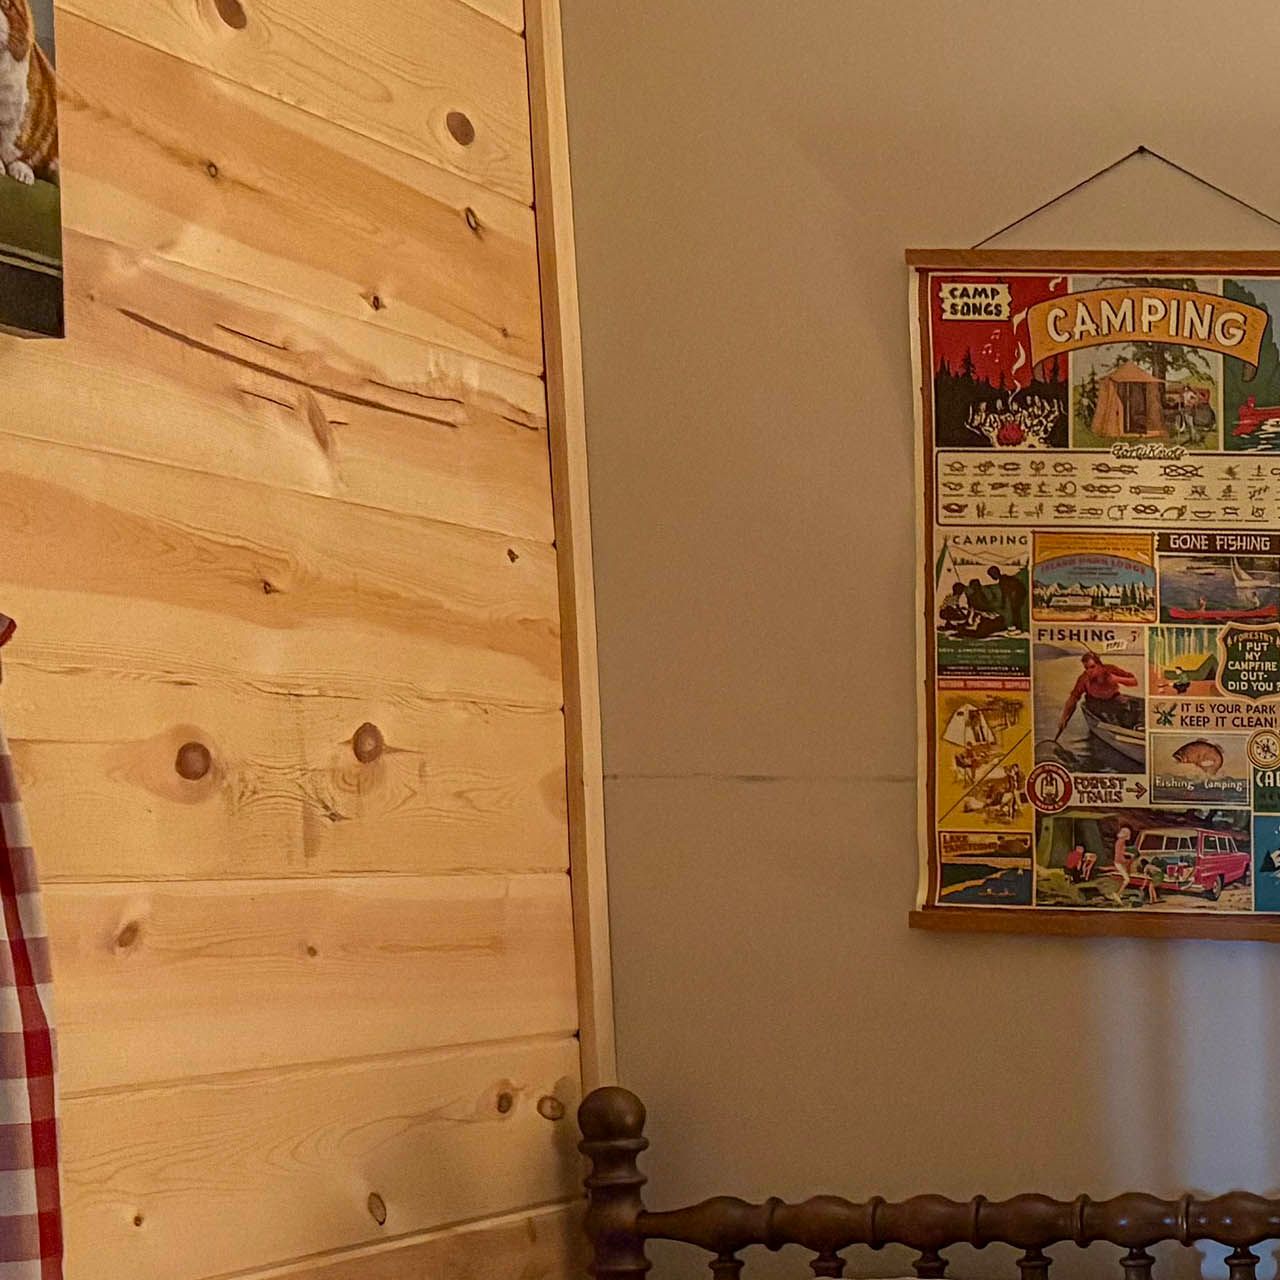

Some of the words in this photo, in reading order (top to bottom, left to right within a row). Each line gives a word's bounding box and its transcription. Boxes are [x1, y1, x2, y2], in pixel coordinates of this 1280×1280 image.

[949, 287, 1000, 300] CAMP
[949, 302, 1003, 316] SONGS
[1046, 297, 1248, 347] CAMPING
[952, 535, 1028, 545] CAMPING
[1170, 534, 1209, 550] GONE
[1215, 535, 1271, 551] FISHING
[1037, 628, 1115, 642] FISHING
[1238, 642, 1242, 651] I
[1246, 642, 1269, 651] PUT
[1245, 652, 1261, 660] MY
[1228, 661, 1278, 671] CAMPFIRE
[1228, 681, 1248, 691] DID
[1180, 703, 1191, 712] IT
[1195, 703, 1205, 713] IS
[1210, 703, 1241, 714] YOUR
[1246, 704, 1276, 714] PARK
[1180, 715, 1210, 727] KEEP
[1215, 716, 1227, 728] IT
[1231, 716, 1278, 728] CLEAN!
[1074, 776, 1127, 790] FOREST
[1155, 777, 1195, 790] Fishing
[1204, 778, 1243, 792] Camping
[1077, 790, 1124, 804] TRAILS
